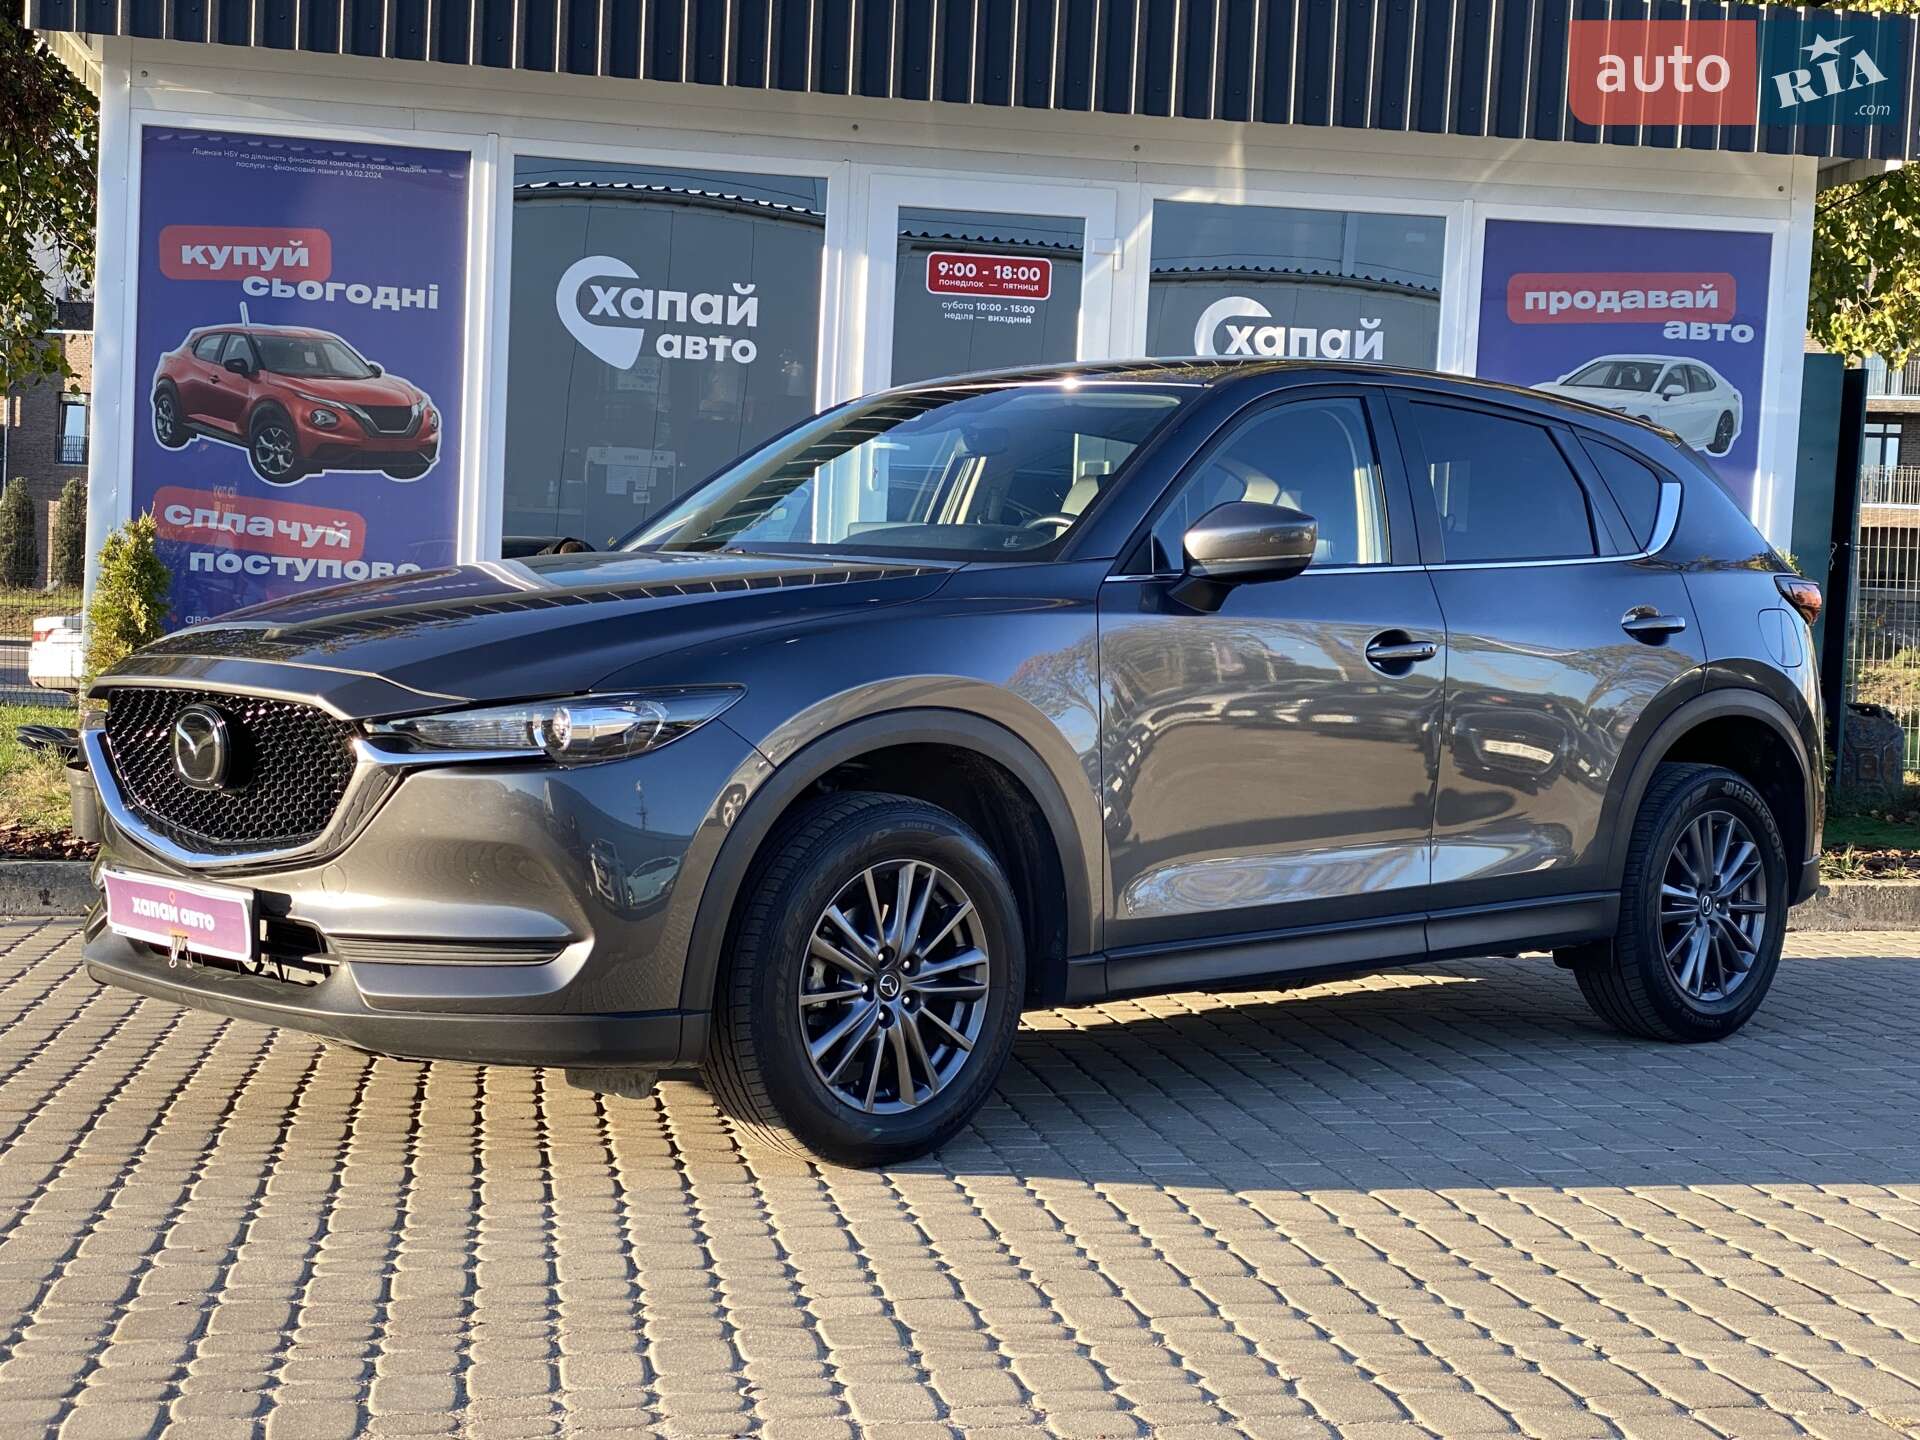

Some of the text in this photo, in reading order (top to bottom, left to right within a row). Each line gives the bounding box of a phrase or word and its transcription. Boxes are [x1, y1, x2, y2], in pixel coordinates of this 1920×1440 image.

[181, 240, 309, 271] купуй
[937, 261, 977, 278] 9:00
[994, 265, 1041, 281] 18:00
[242, 276, 439, 311] сьогодні
[939, 279, 984, 288] понеділок
[588, 282, 759, 328] хапай
[942, 301, 974, 313] субота
[976, 302, 1002, 312] 10:00
[1010, 305, 1036, 314] 15:00
[1524, 284, 1718, 315] продавай
[944, 312, 974, 321] неділя
[988, 314, 1032, 325] вихідний
[1663, 320, 1755, 343] авто
[655, 333, 758, 364] авто
[1224, 318, 1384, 361] хапай
[164, 504, 351, 549] сплачуй
